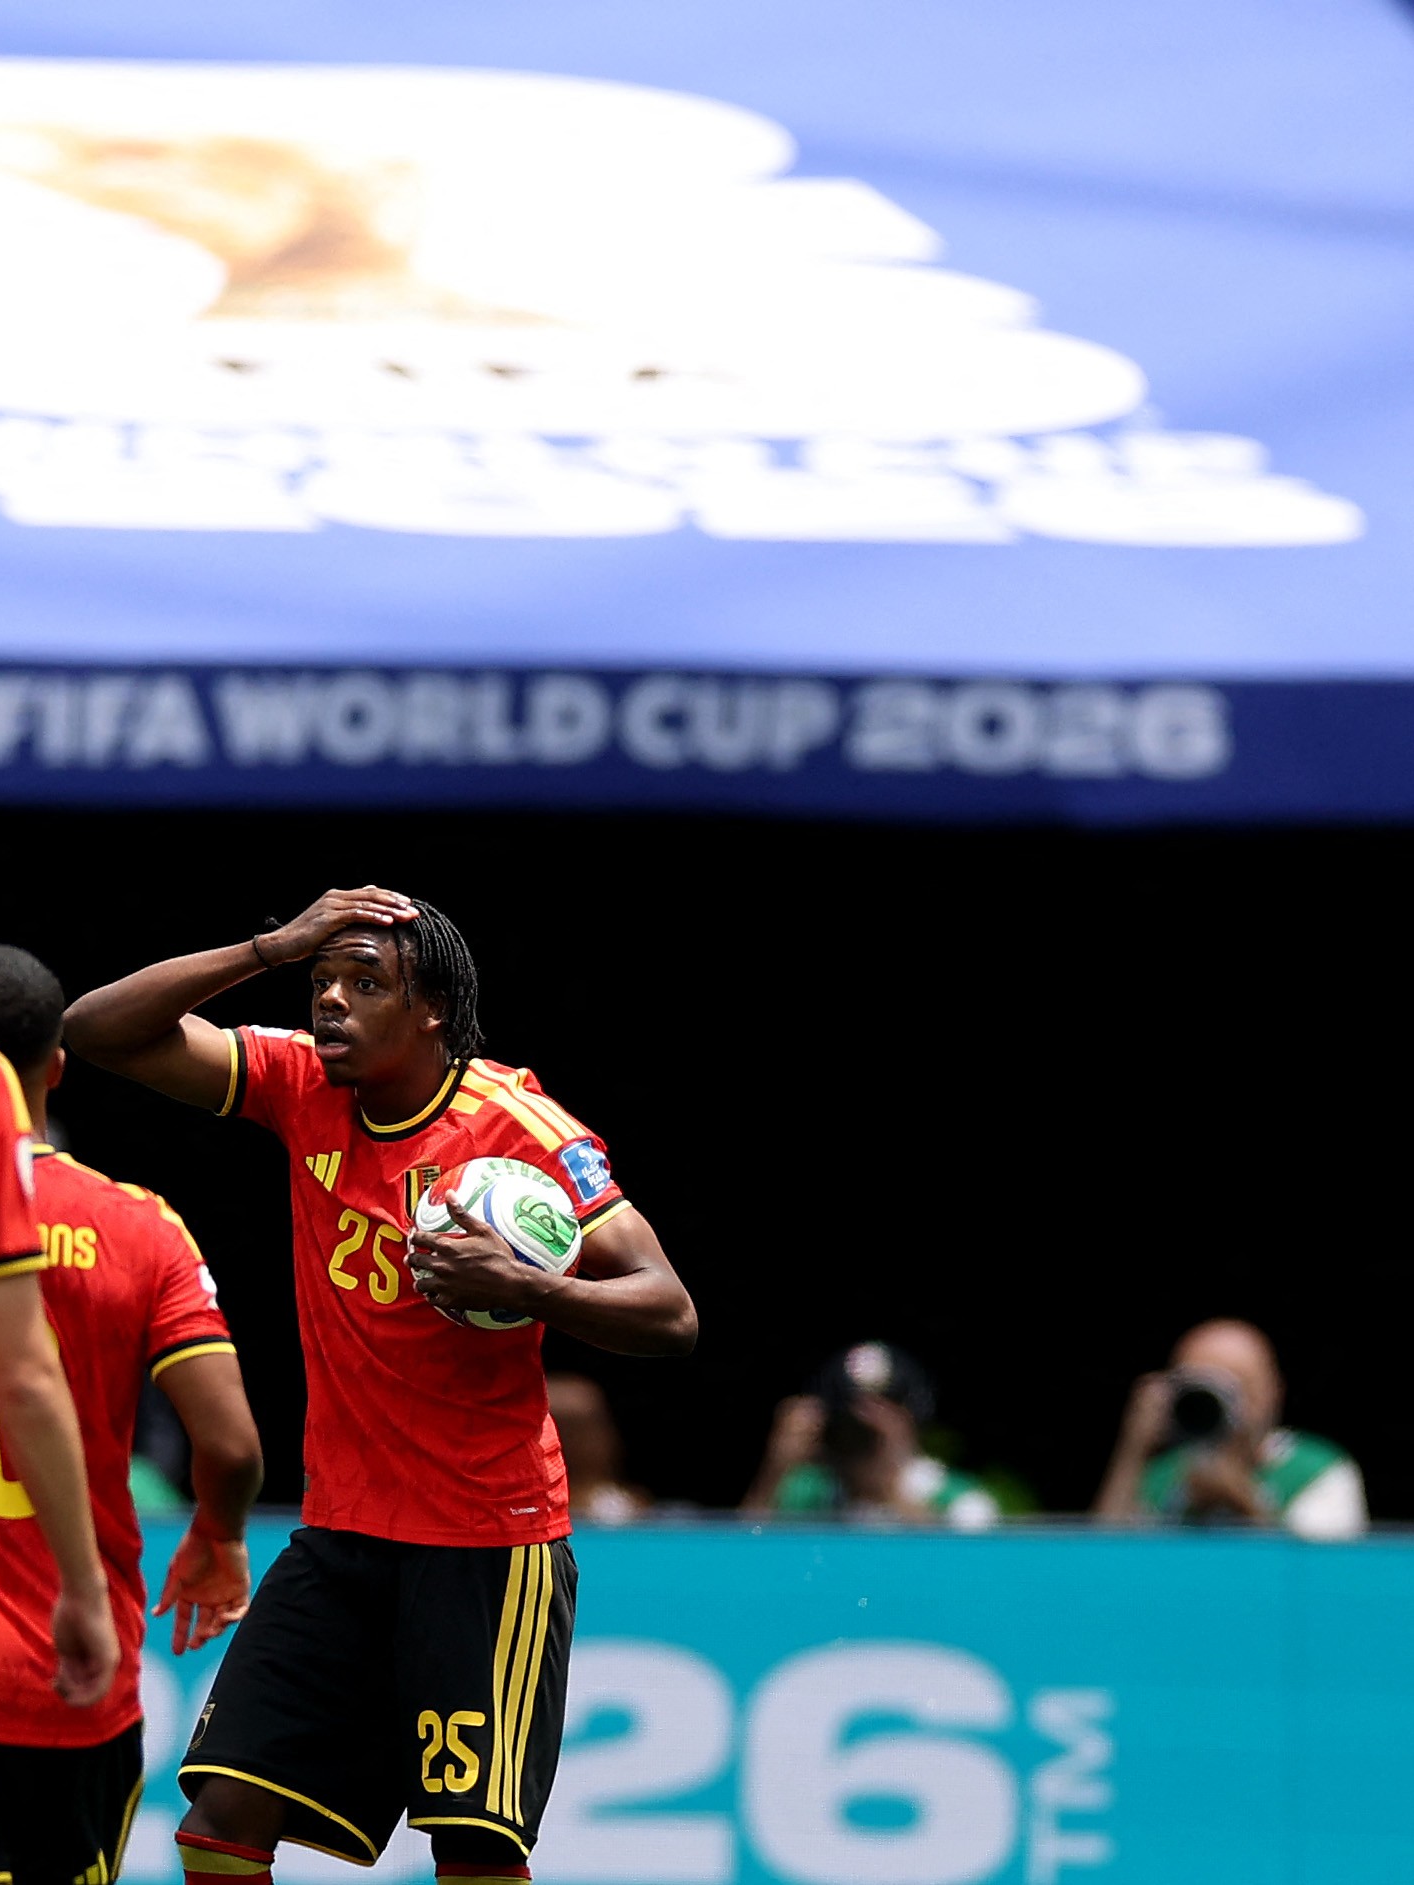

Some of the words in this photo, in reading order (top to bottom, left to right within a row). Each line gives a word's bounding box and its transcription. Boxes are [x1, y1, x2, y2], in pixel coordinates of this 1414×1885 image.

[216, 674, 610, 768] WORLD
[620, 674, 838, 770] CUP
[844, 678, 1232, 780] 2026
[328, 1208, 403, 1304] 25
[417, 1710, 486, 1793] 25
